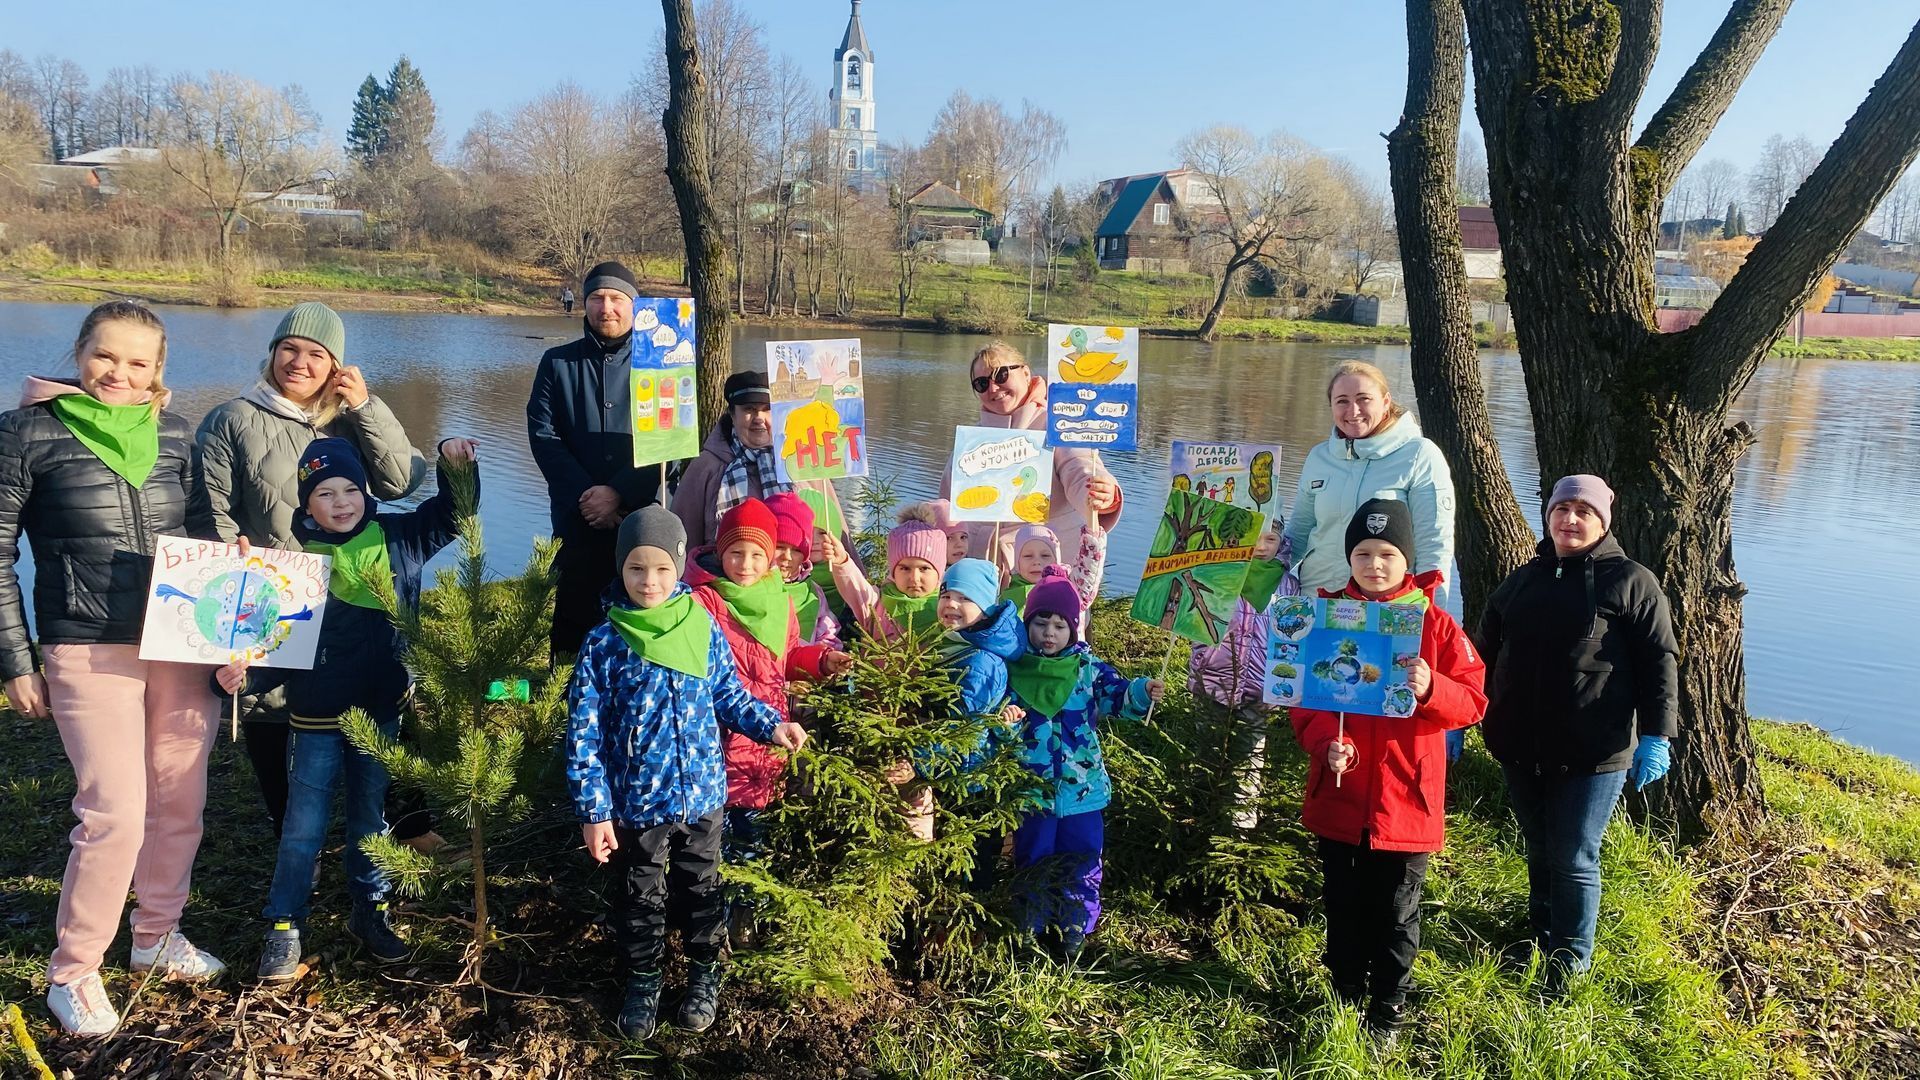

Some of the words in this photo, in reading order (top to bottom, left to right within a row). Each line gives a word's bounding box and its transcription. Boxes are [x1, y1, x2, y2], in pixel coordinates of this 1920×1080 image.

[1099, 422, 1115, 430] ОНИ
[795, 426, 862, 469] НЕТ
[964, 453, 976, 464] НЕ
[981, 438, 1024, 457] КОРМИТЕ
[1187, 445, 1237, 457] ПОСАДИ
[1195, 457, 1238, 469] ДЕРЕВО
[163, 542, 248, 570] БЕРЕГ
